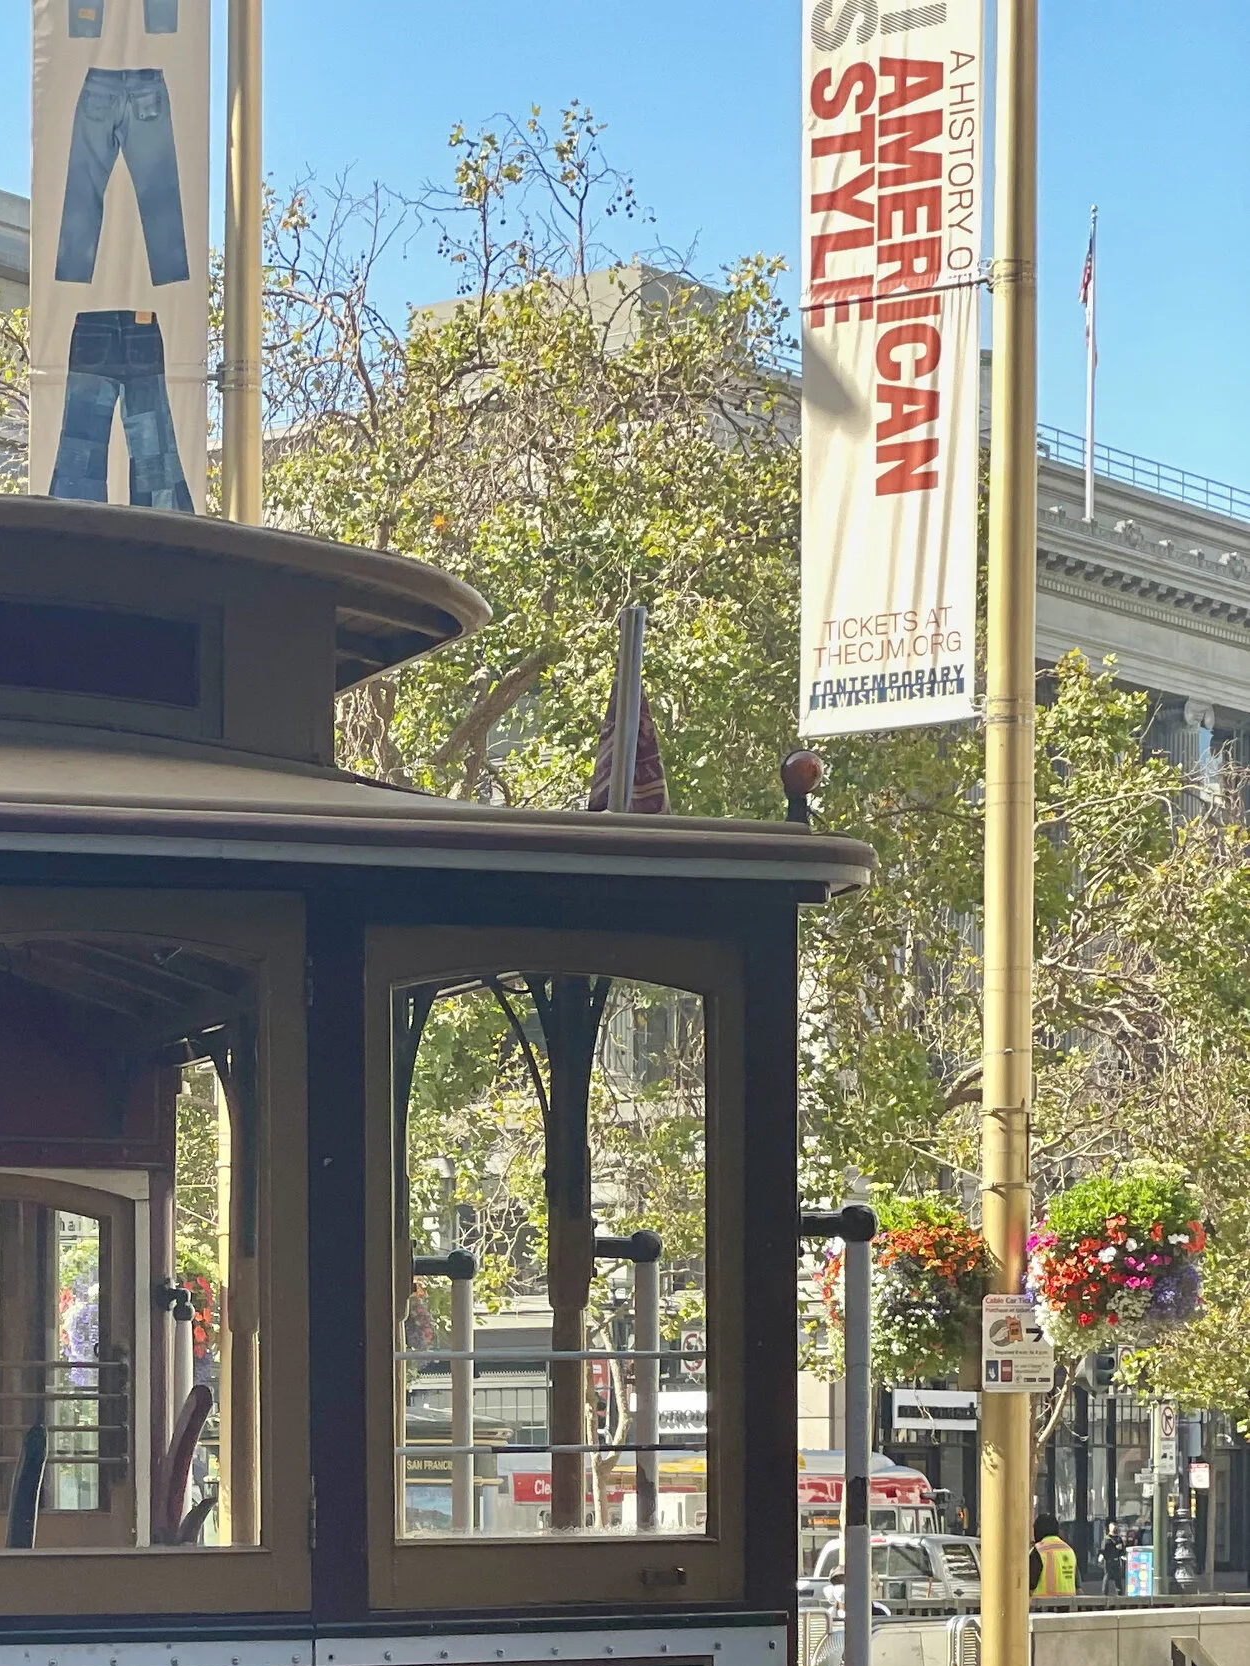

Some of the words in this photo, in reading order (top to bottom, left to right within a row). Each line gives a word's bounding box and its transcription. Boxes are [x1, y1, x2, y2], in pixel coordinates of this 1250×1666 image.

[949, 50, 976, 75] A
[947, 81, 976, 235] HISTORY
[810, 61, 878, 329] STYLE
[875, 56, 944, 497] AMERICAN
[822, 610, 918, 641] TICKETS
[924, 605, 953, 629] AT
[813, 630, 962, 669] THECJM.ORG
[812, 663, 965, 697] CONTEMPORARY
[886, 680, 958, 702] MUSEUM
